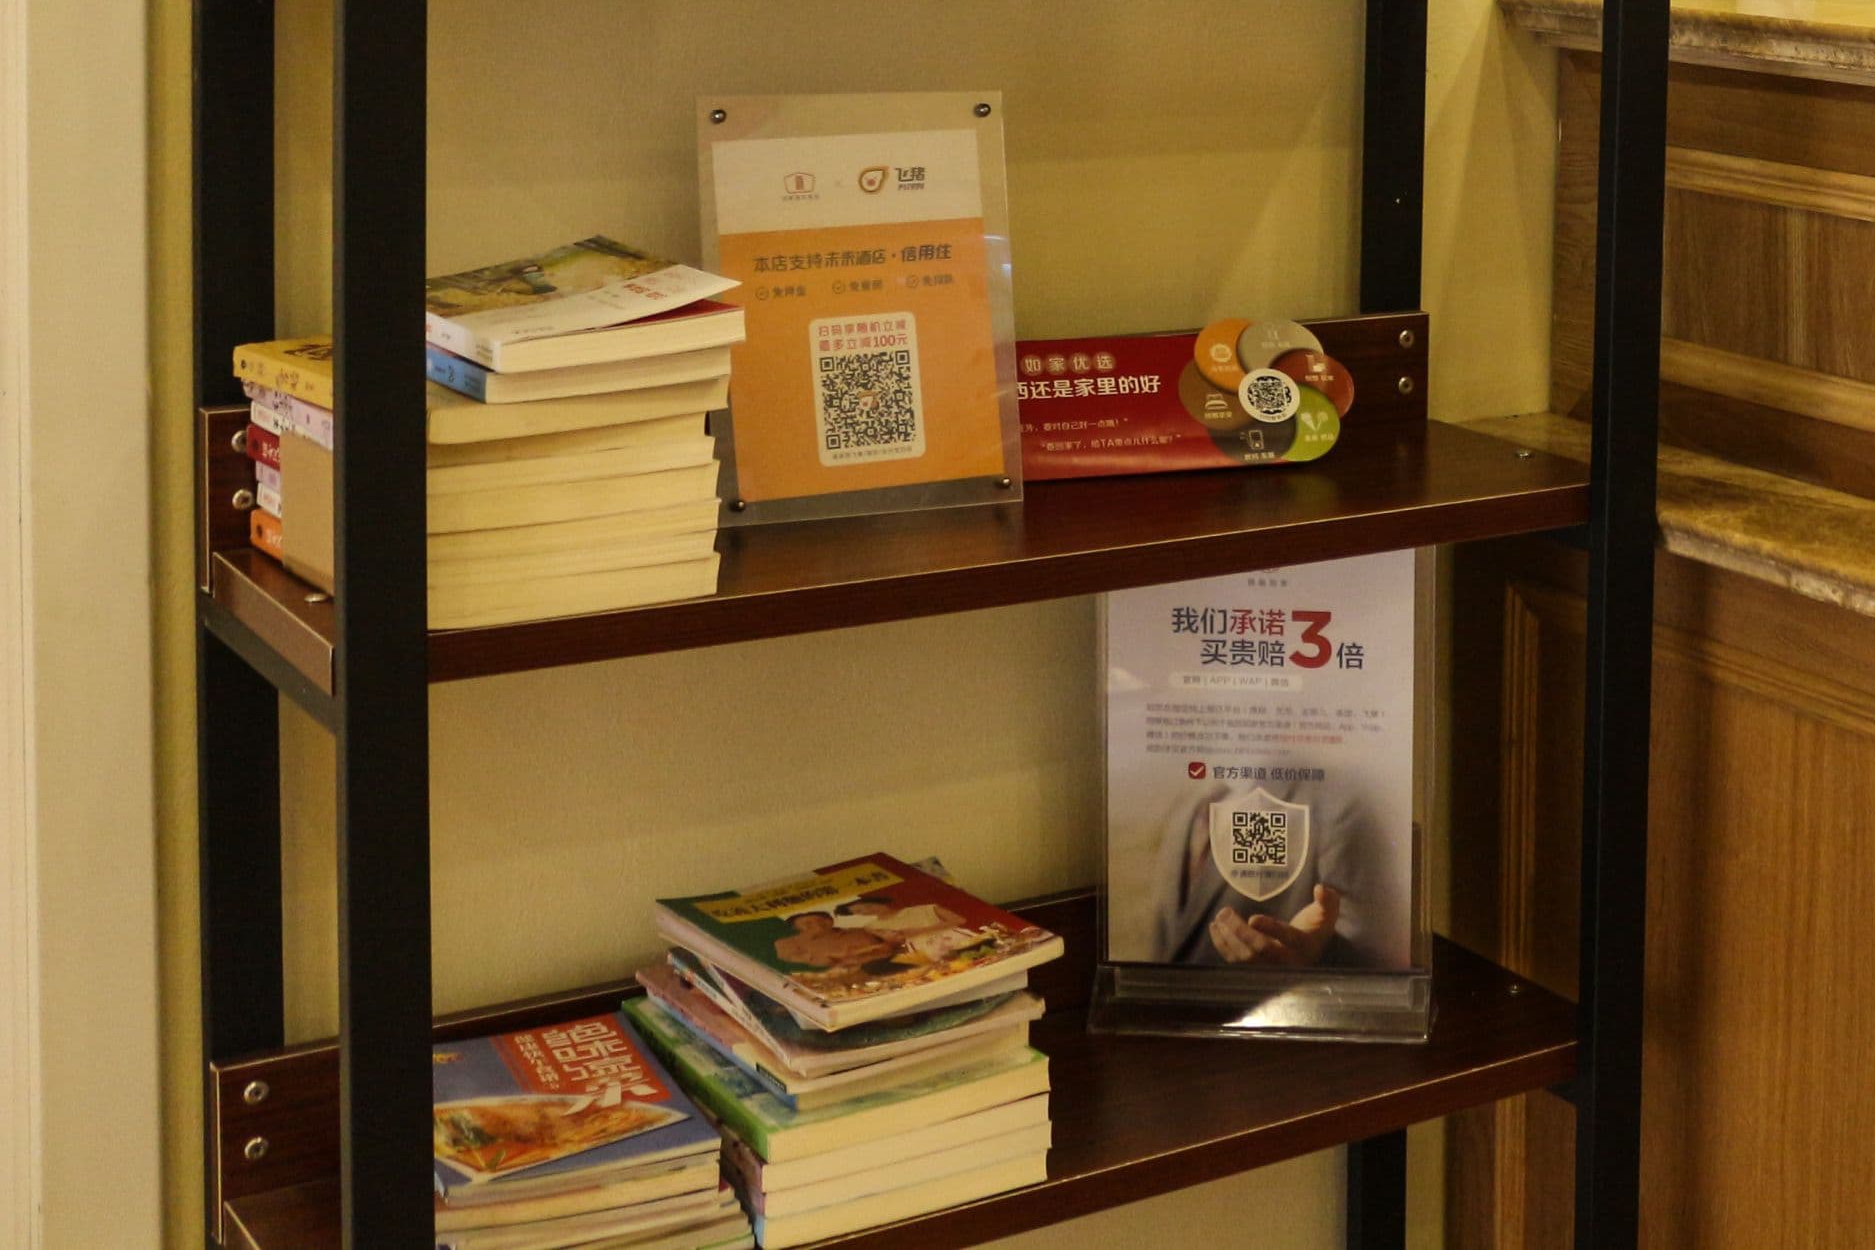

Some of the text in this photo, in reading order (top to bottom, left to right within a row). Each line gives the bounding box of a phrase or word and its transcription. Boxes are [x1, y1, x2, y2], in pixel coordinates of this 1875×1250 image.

[1025, 355, 1113, 372] 如家优选
[1172, 606, 1286, 636] 我们承诺
